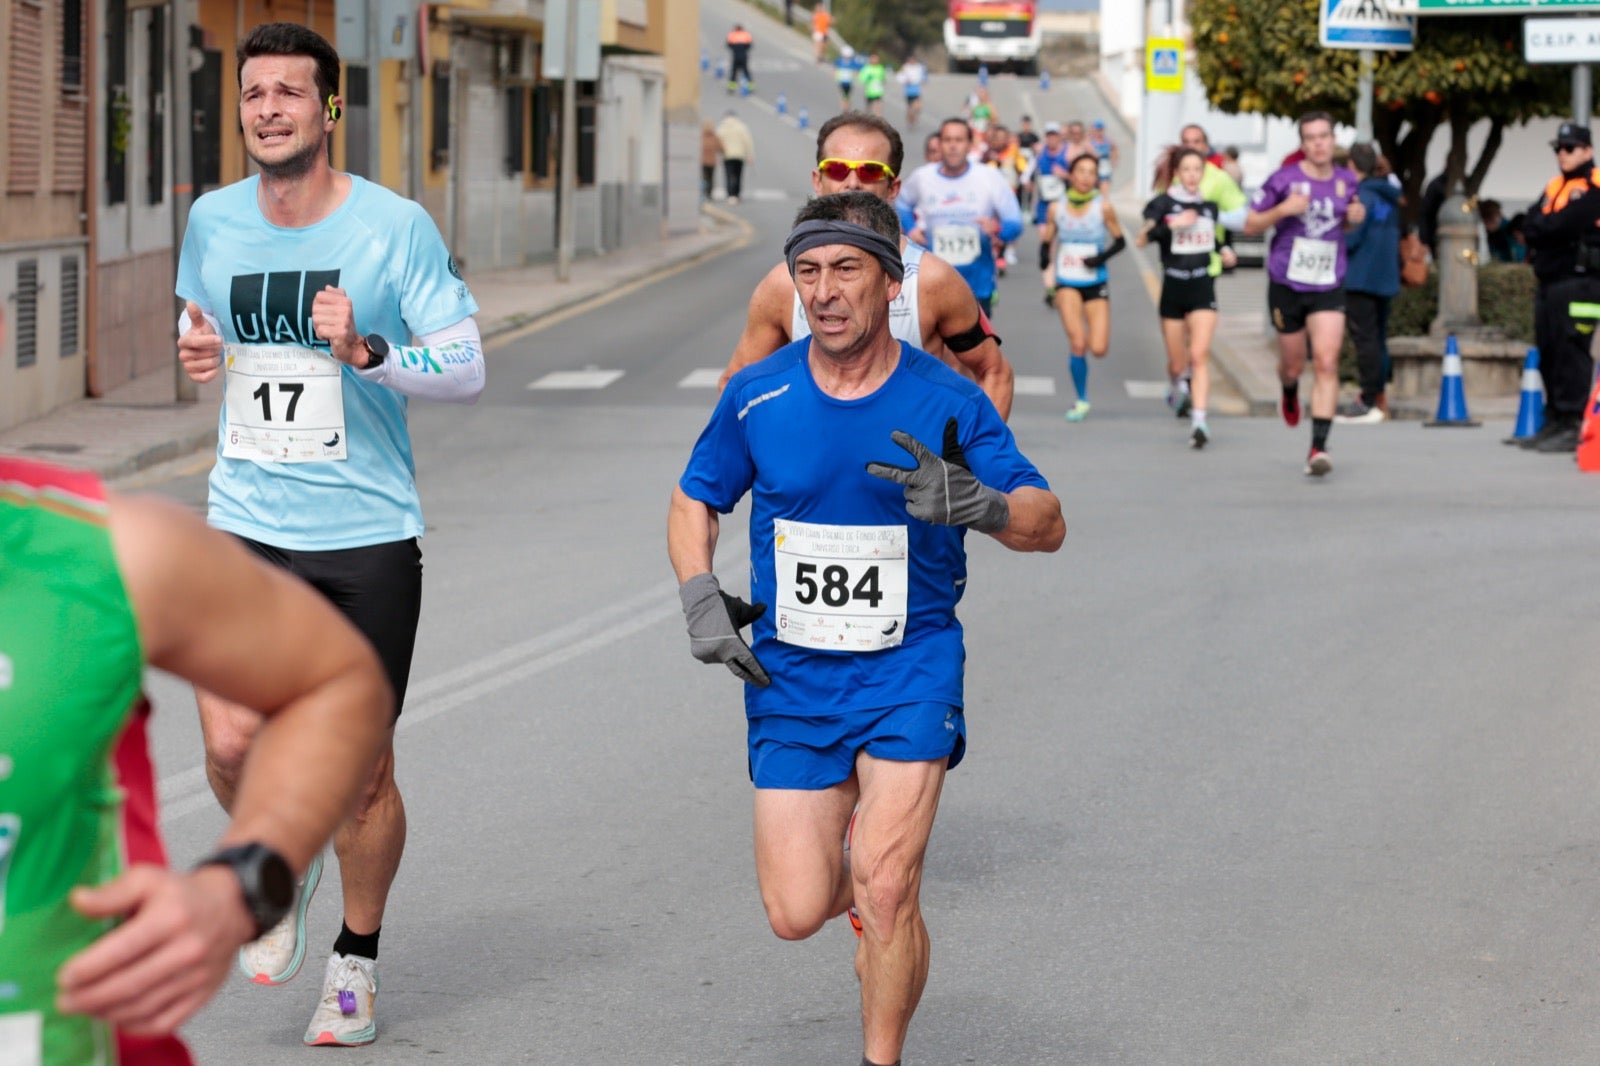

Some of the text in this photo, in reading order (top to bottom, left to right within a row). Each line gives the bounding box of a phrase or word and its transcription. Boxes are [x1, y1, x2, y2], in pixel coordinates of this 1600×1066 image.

[1587, 32, 1600, 46] A
[235, 312, 328, 345] UAL
[253, 382, 304, 422] 17
[795, 561, 883, 608] 584
